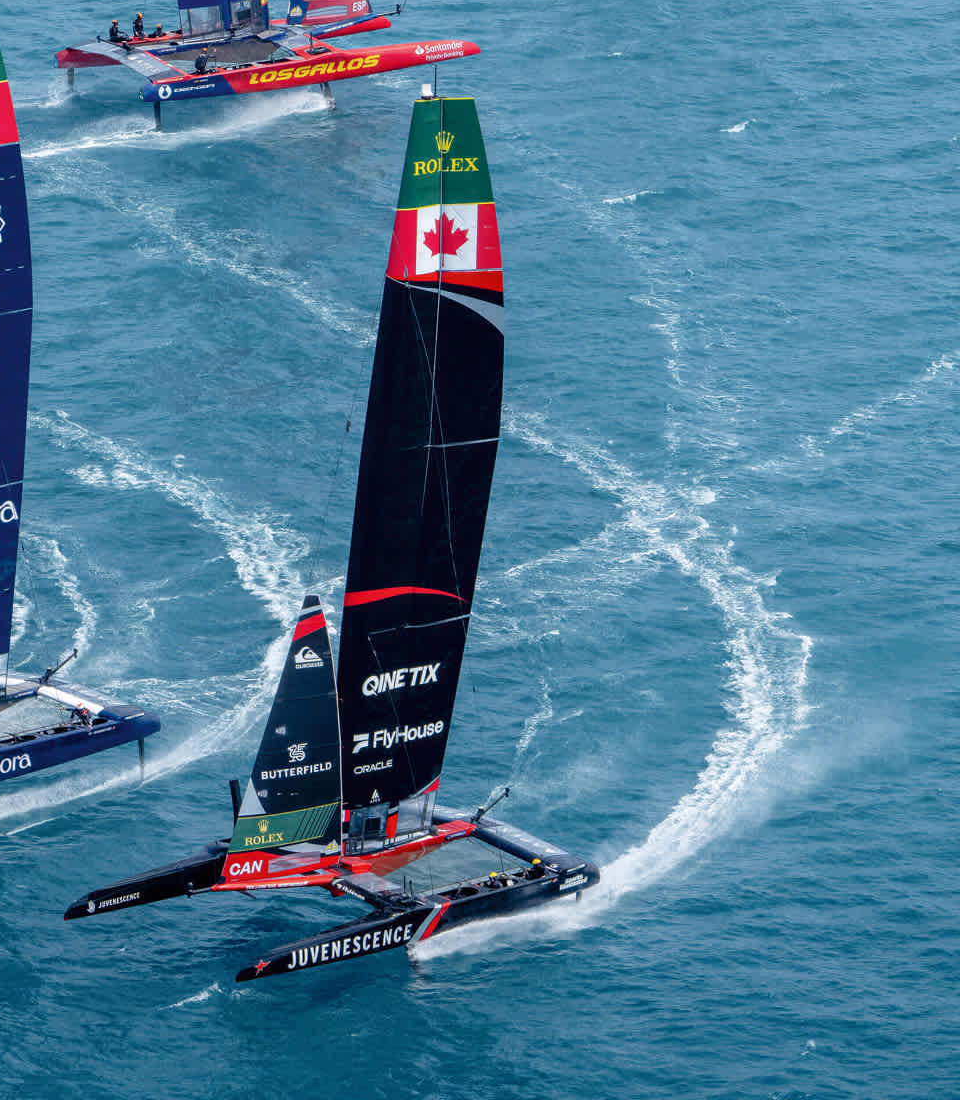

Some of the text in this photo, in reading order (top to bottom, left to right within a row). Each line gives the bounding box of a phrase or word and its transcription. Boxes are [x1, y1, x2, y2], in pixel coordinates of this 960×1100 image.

[352, 0, 367, 12] ESP
[424, 41, 464, 53] Santander
[413, 157, 480, 176] ROLEX
[373, 720, 444, 749] FlyHouse
[261, 761, 333, 781] BUTTERFIELD
[353, 758, 393, 775] ORACLE
[244, 831, 284, 847] ROLEX
[229, 860, 263, 877] CAN
[98, 892, 141, 909] JUVENESCENCE
[287, 923, 414, 970] JUVENESCENCE
